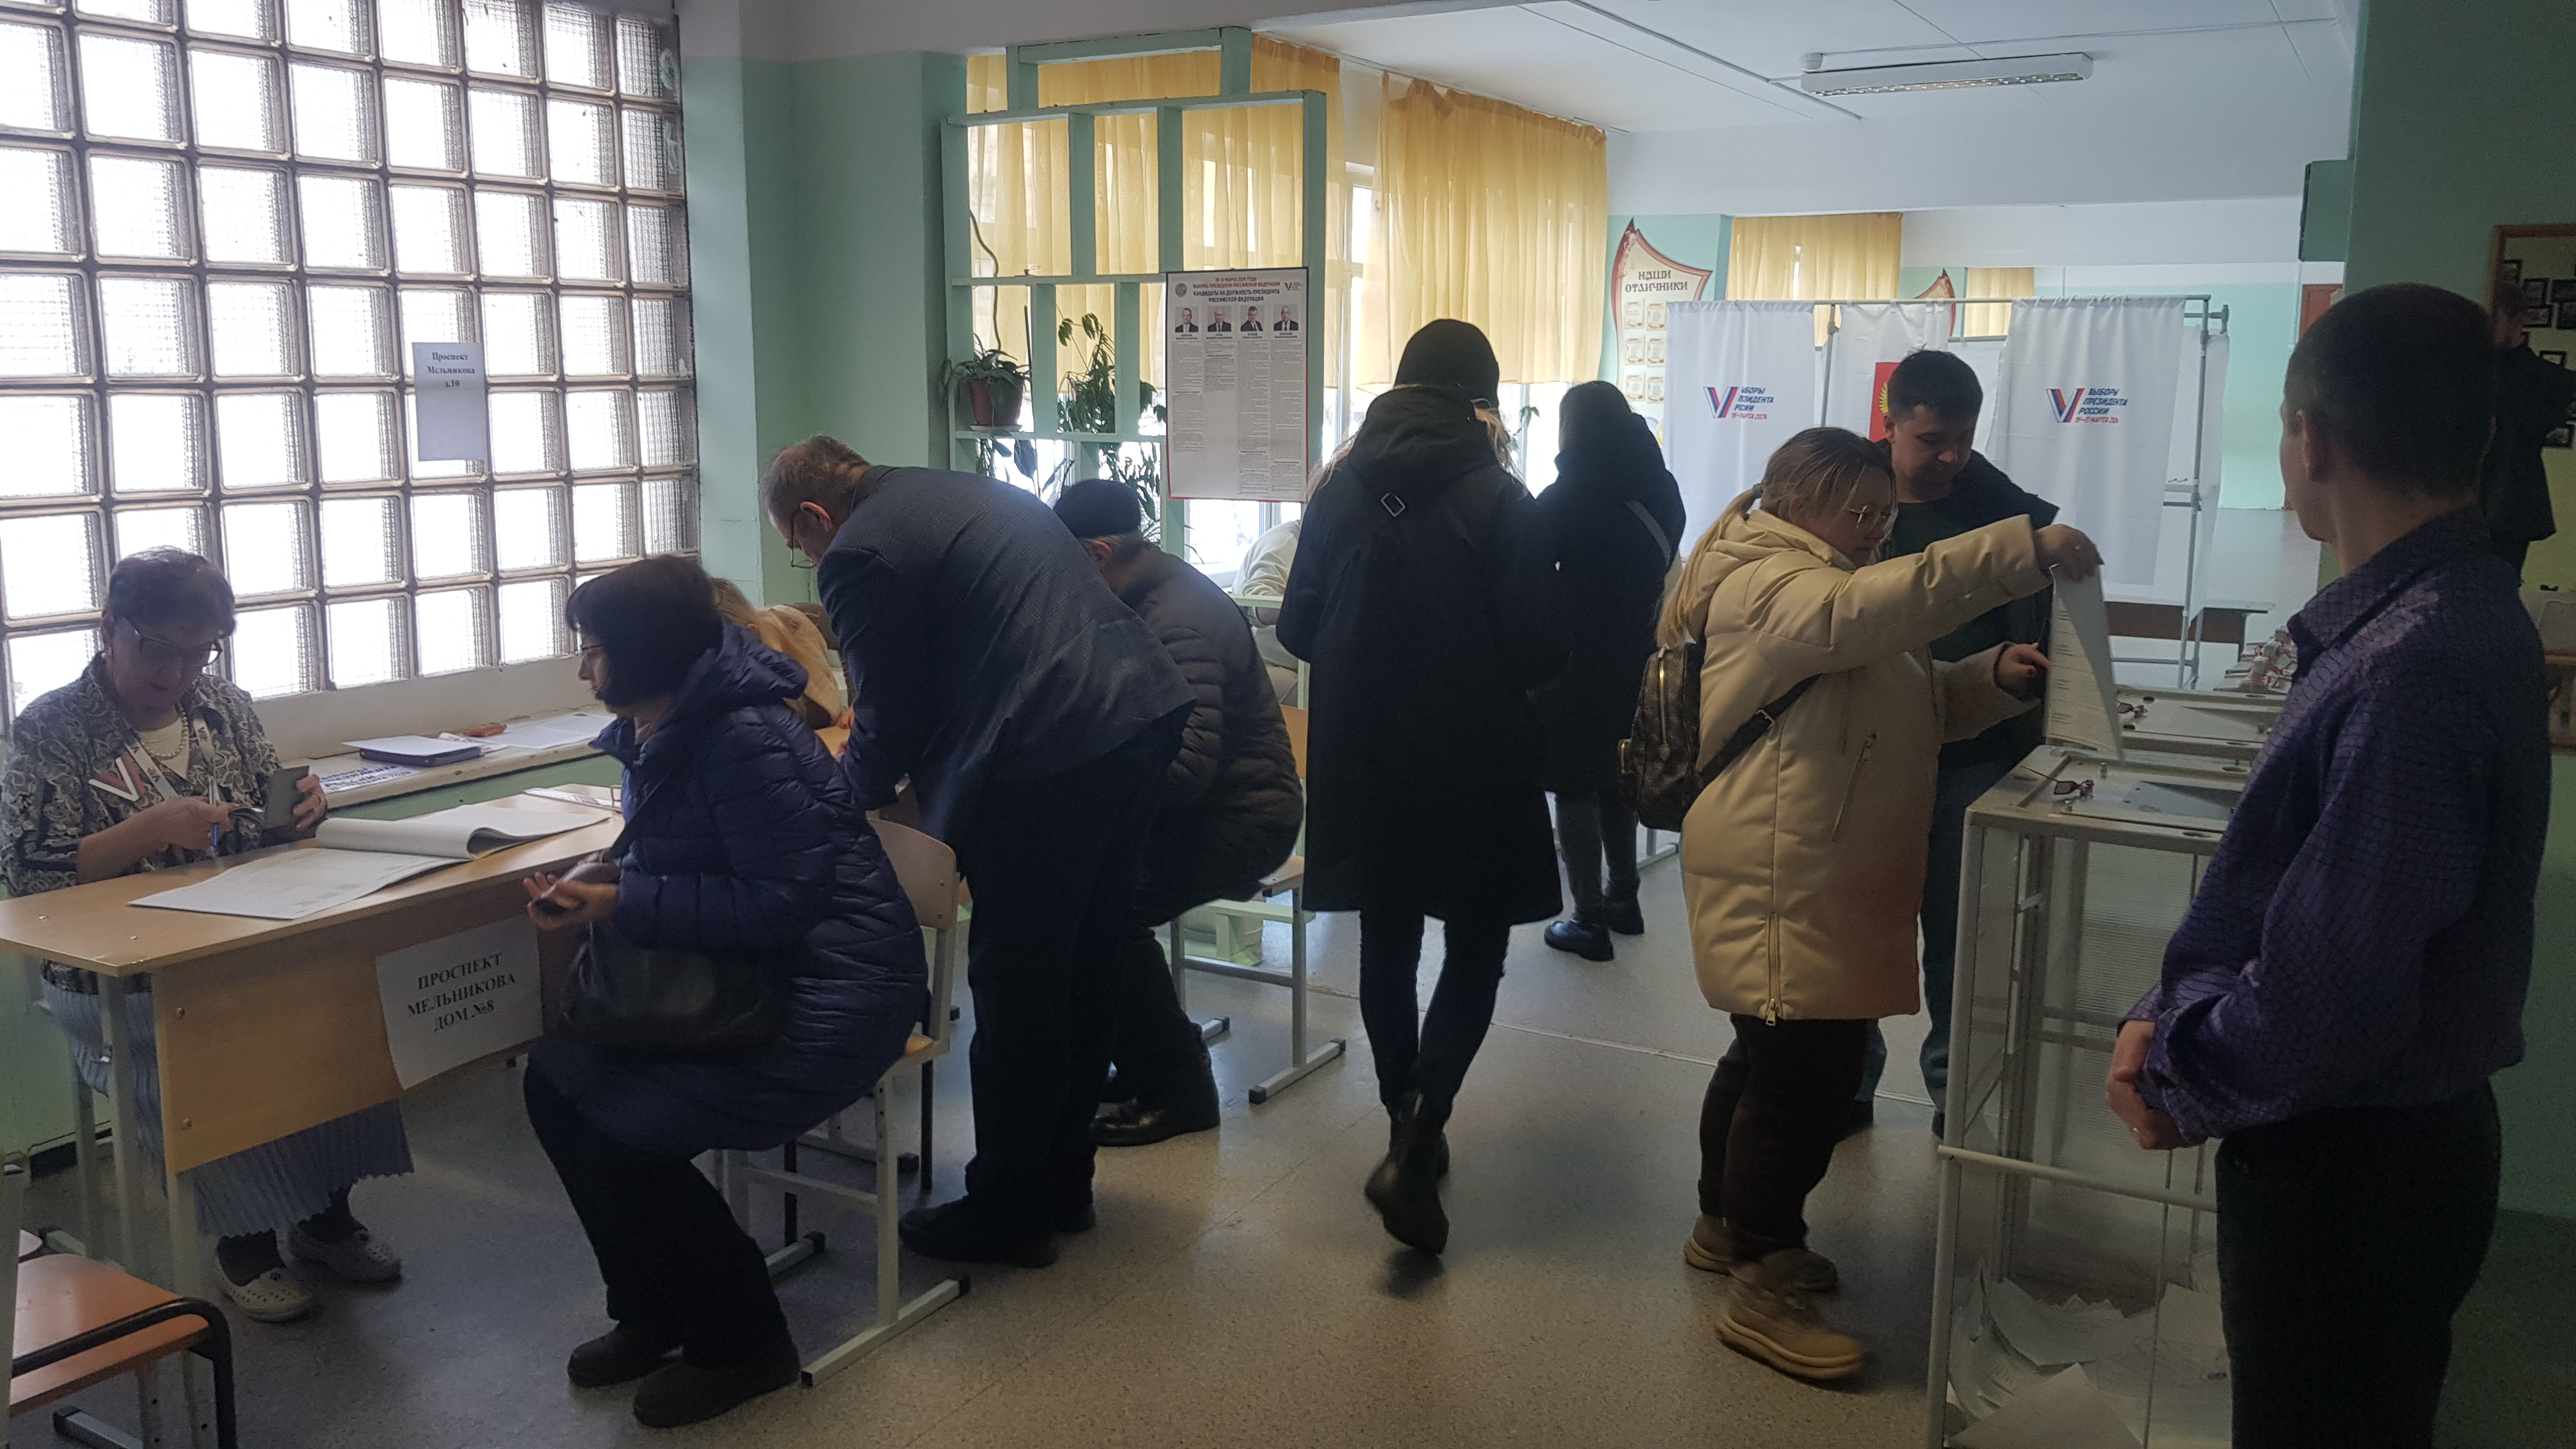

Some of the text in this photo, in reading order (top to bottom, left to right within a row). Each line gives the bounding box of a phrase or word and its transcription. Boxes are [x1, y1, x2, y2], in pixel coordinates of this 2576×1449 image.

[1638, 270, 1671, 280] НАШИ
[1625, 281, 1688, 293] ОТЛИЧНИКИ
[432, 352, 468, 362] Проспект
[427, 365, 475, 374] Мельникова
[418, 952, 503, 990] ПРОСПЕКТ
[408, 973, 516, 1015] МЕЛЬНИКОВА
